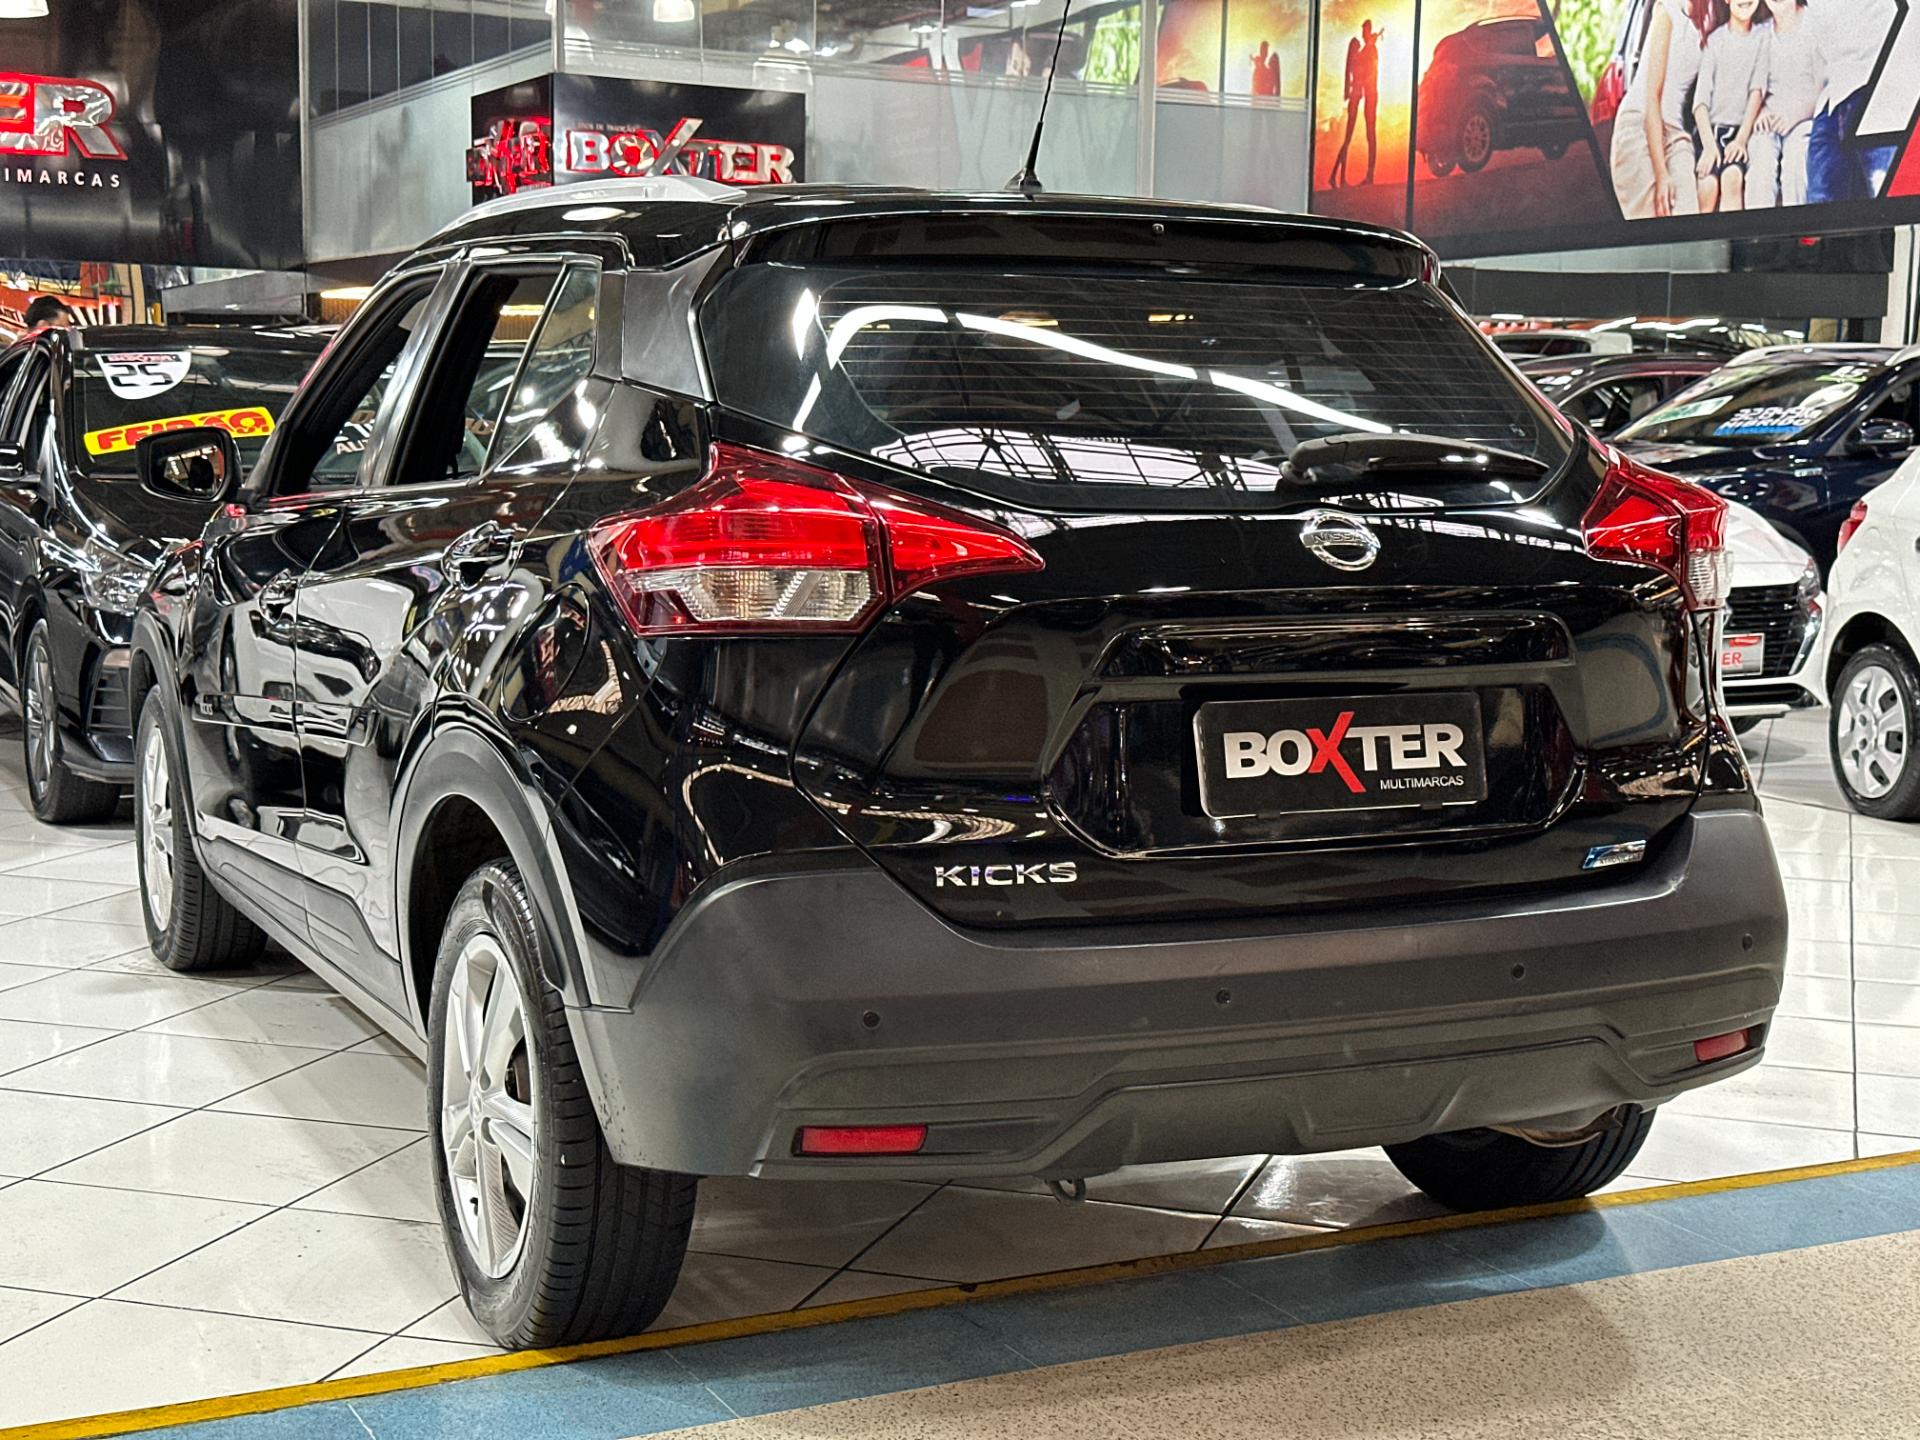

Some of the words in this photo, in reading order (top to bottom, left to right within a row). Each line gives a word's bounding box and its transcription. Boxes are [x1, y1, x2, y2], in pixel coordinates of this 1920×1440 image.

[565, 117, 797, 184] BOXTER
[108, 362, 174, 388] 25
[1223, 711, 1467, 793] BOXTER
[1380, 775, 1464, 790] MULTIMARCAS
[934, 861, 1078, 887] KICKS
